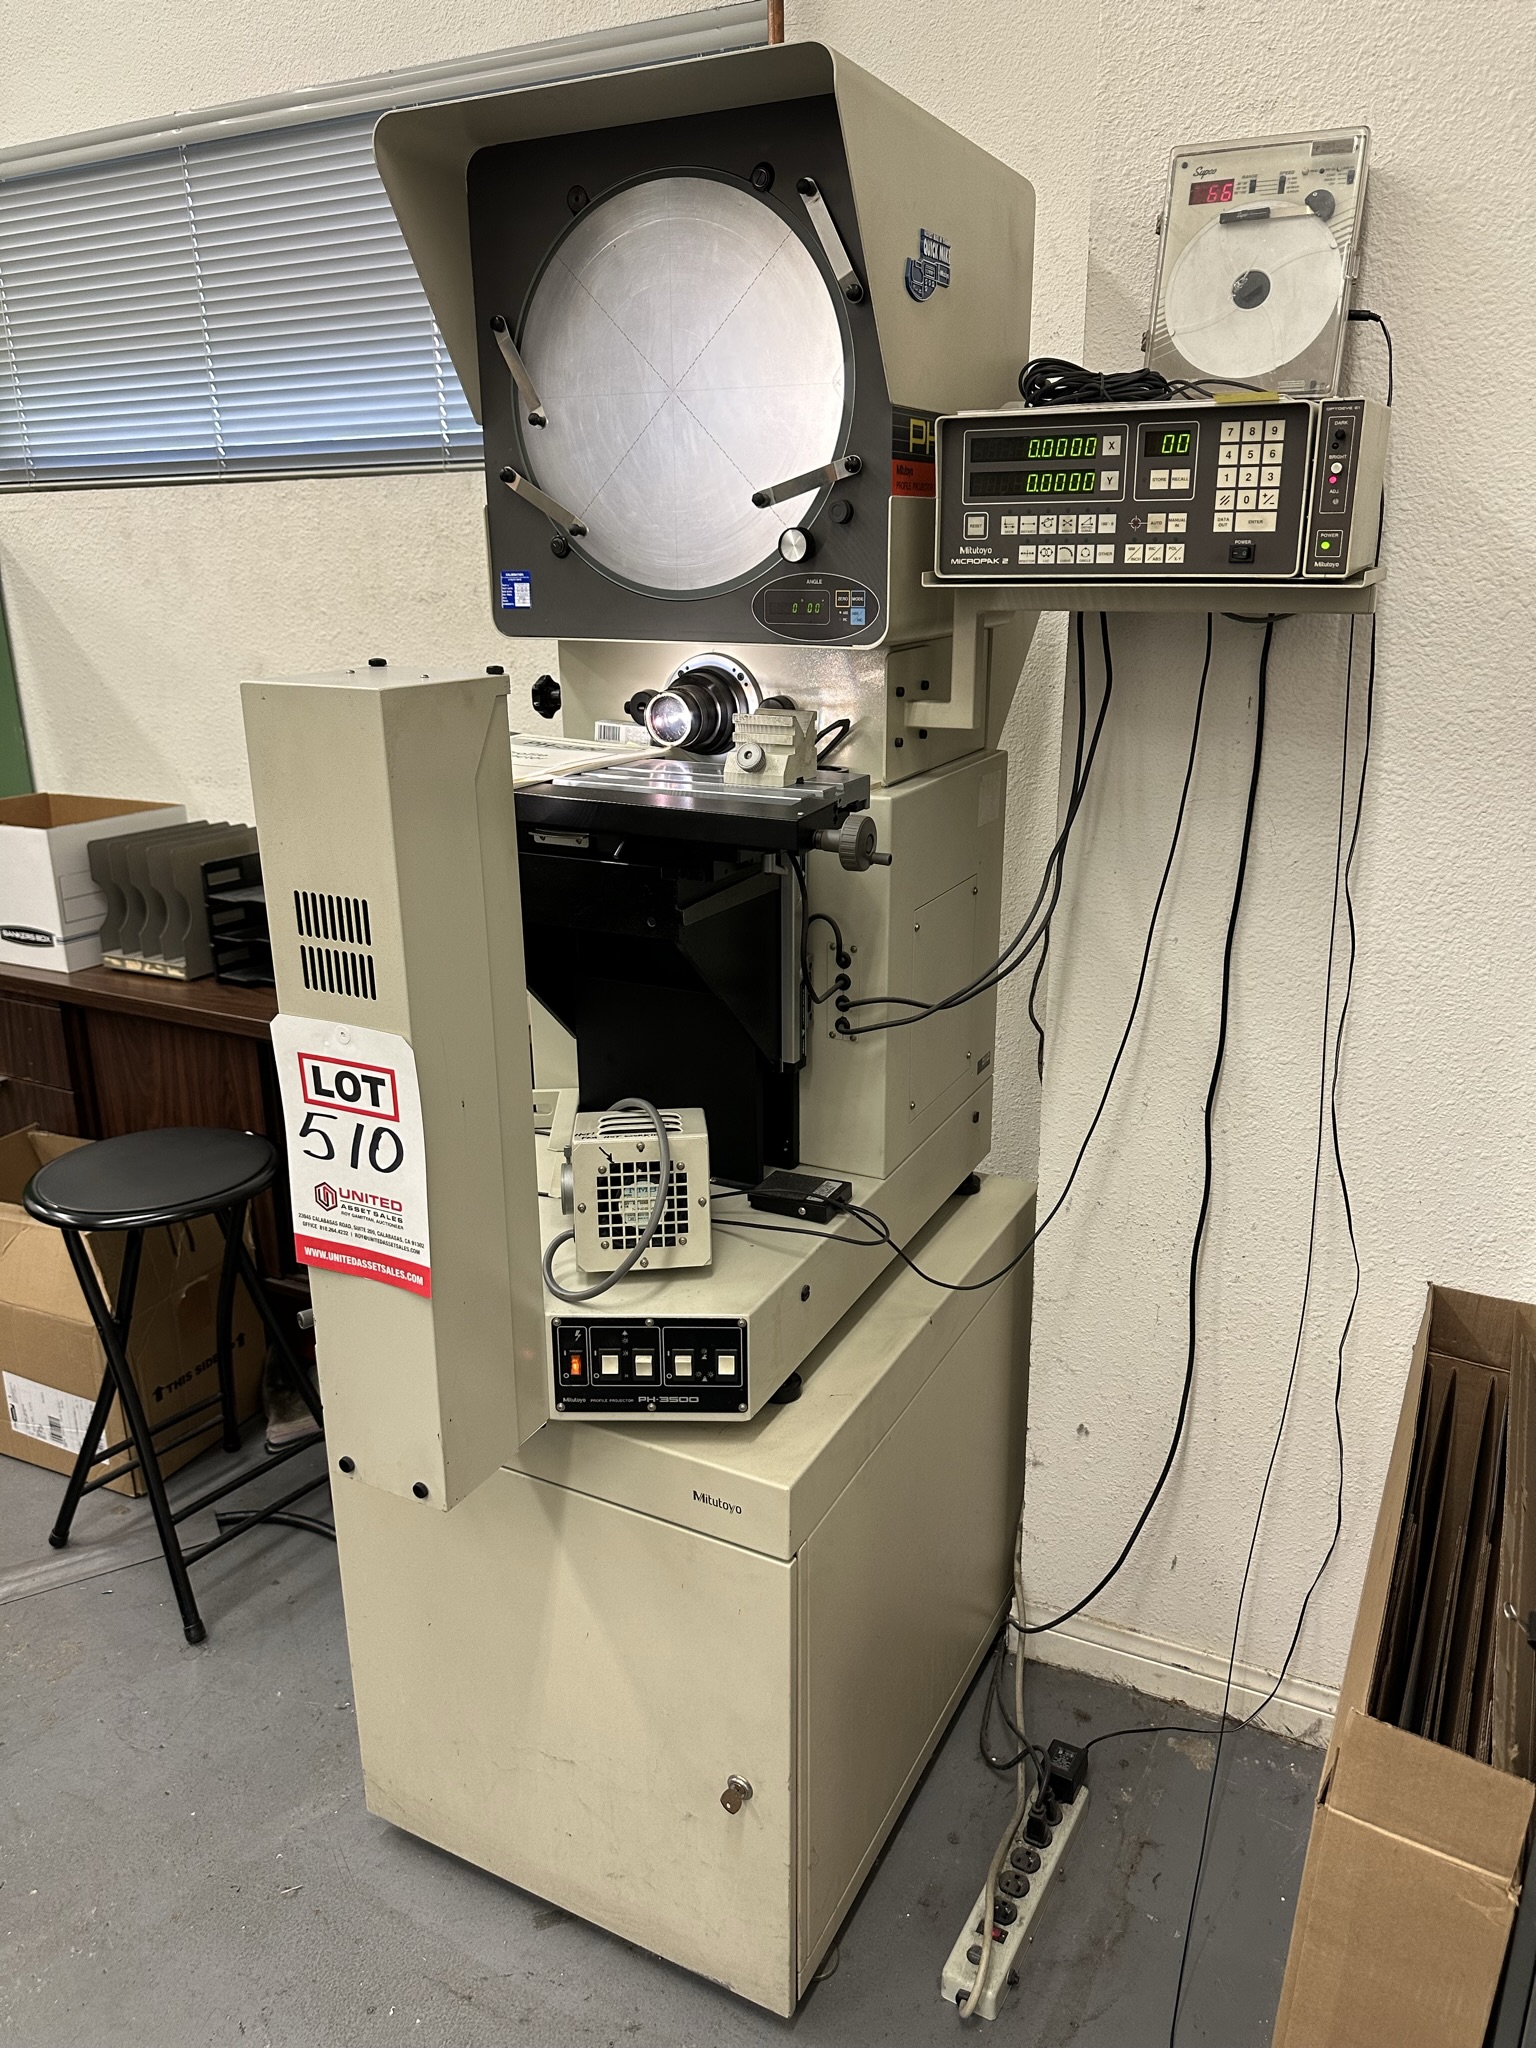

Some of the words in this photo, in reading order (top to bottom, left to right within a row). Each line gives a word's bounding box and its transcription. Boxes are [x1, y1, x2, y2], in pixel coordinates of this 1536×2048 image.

[1193, 166, 1217, 179] Supco
[1206, 183, 1233, 202] 66
[1227, 427, 1234, 436] 7
[1249, 426, 1256, 436] 8
[1271, 426, 1278, 435] 9
[1027, 437, 1098, 458] 0.0000
[1108, 441, 1115, 450] X
[1161, 433, 1191, 454] 00
[1225, 450, 1232, 459] 4
[1247, 450, 1254, 459] 5
[1269, 449, 1276, 459] 6
[1025, 472, 1096, 493] 0.0000
[1106, 476, 1113, 485] Y
[1224, 473, 1229, 482] 1
[1245, 473, 1252, 482] 2
[1267, 472, 1274, 482] 3
[1243, 495, 1250, 504] 0
[959, 546, 993, 555] Mitutoyo
[950, 557, 999, 565] MICROPAK
[1001, 557, 1009, 565] 2
[311, 1064, 386, 1108] LOT
[299, 1111, 404, 1174] 510
[338, 1187, 403, 1213] UNITED
[340, 1204, 372, 1215] ASSET
[372, 1210, 404, 1224] SALES
[304, 1246, 424, 1286] WWW.UNITEDASSETSALES.COM
[165, 1370, 193, 1394] THIS
[693, 1490, 743, 1515] Mitutoyo
